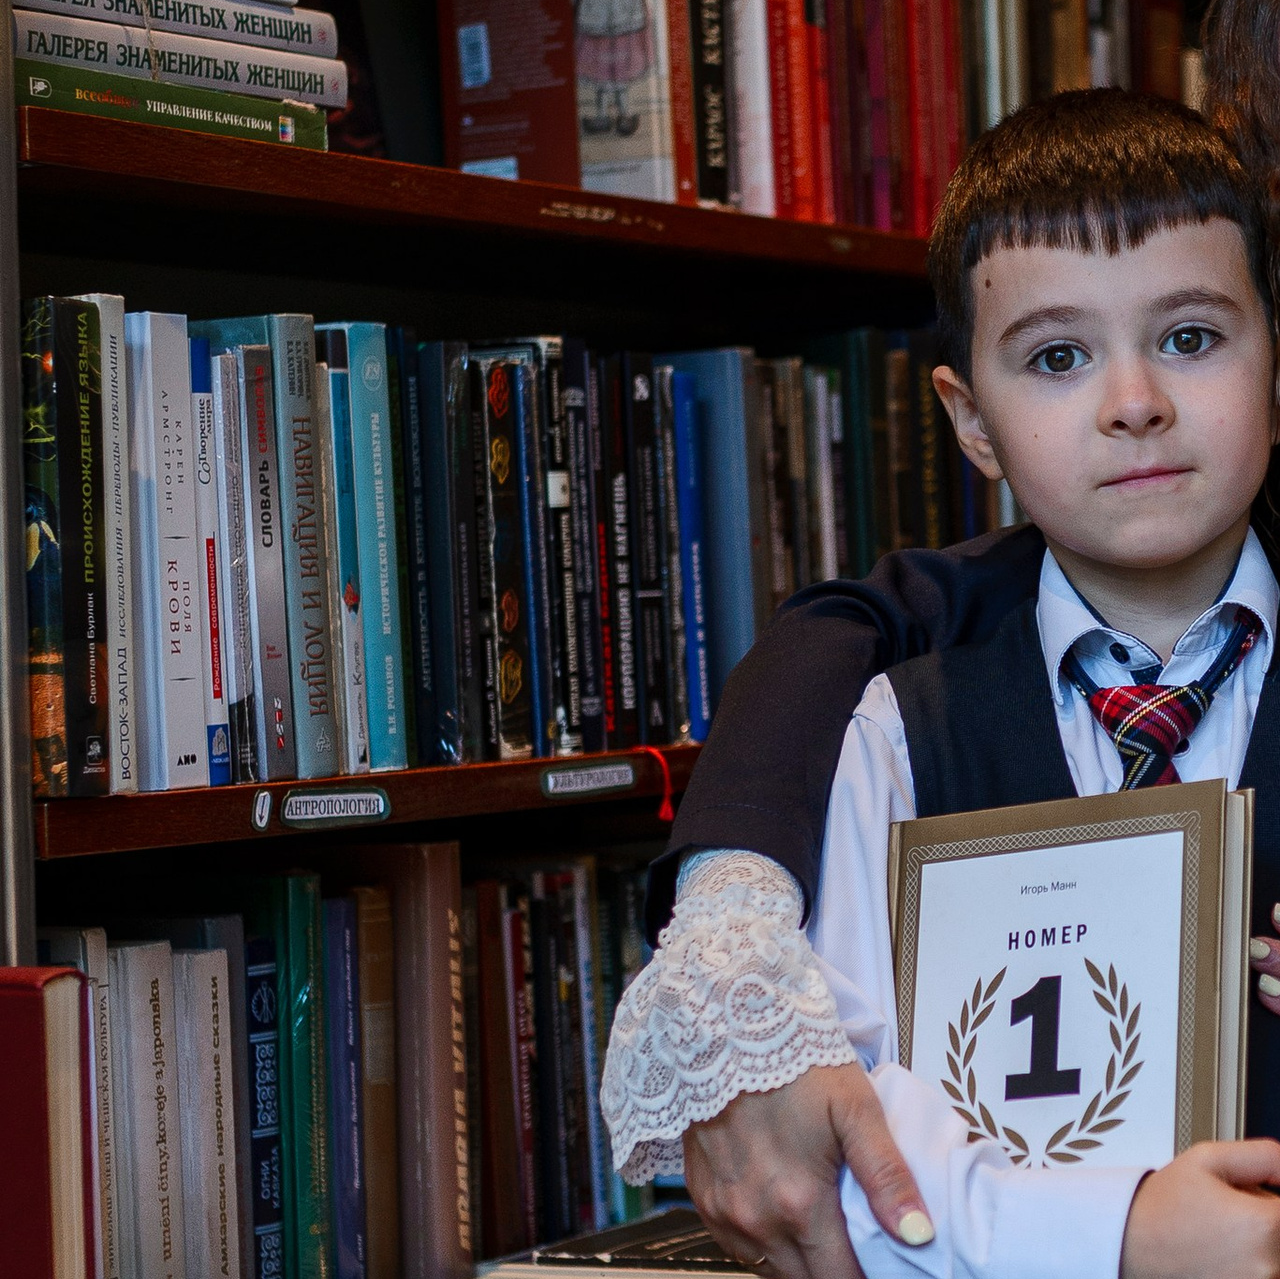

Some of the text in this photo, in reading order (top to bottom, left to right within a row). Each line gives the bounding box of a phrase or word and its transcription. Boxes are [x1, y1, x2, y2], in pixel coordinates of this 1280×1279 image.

[233, 12, 313, 45] ЖЕНЩИН
[28, 30, 325, 95] ГАЛЕРЕЯ ЗНАМЕНИТЫХ ЖЕНЩИН
[146, 99, 271, 132] УПРАВЛЕНИЕ КАЧЕСТВОМ
[206, 399, 214, 434] мира
[161, 390, 174, 513] АРМСТРОНГ
[174, 420, 184, 485] КАРЕН
[254, 366, 273, 548] СЛОВАРЬ СИМВОЛОВ
[76, 312, 99, 704] Светлана Бурлак ПРОИСХОЖДЕНИЕ ЯЗЫКА
[109, 335, 131, 780] ВОСТОК-ЗАПАД ИССЛЕДОВАНИЯ ПЕРЕВОДЫ ПУБЛИКАЦИИ
[291, 416, 329, 717] НАВИГАЦИЯ И ЛОЦИЯ
[371, 412, 397, 709] РОМАНОВ ИСТОРИЧЕСКОЕ РАЗВИТИЕ КУЛЬТУРЫ
[166, 559, 182, 655] КРОВИ
[182, 579, 192, 633] ПОЛЯ
[207, 545, 220, 690] Рождение современности
[287, 799, 380, 816] АНТРОПОЛОГИЯ
[1019, 878, 1078, 899] Игорь Манн
[1008, 924, 1089, 951] НОМЕР
[98, 995, 109, 1061] КУЛЬТУРА
[1004, 975, 1082, 1102] 1
[100, 1066, 111, 1134] ЧЕШСКАЯ
[208, 975, 229, 1275] Амхарские народные сказки
[261, 1160, 271, 1199] ОГНИ
[157, 1195, 171, 1261] umění
